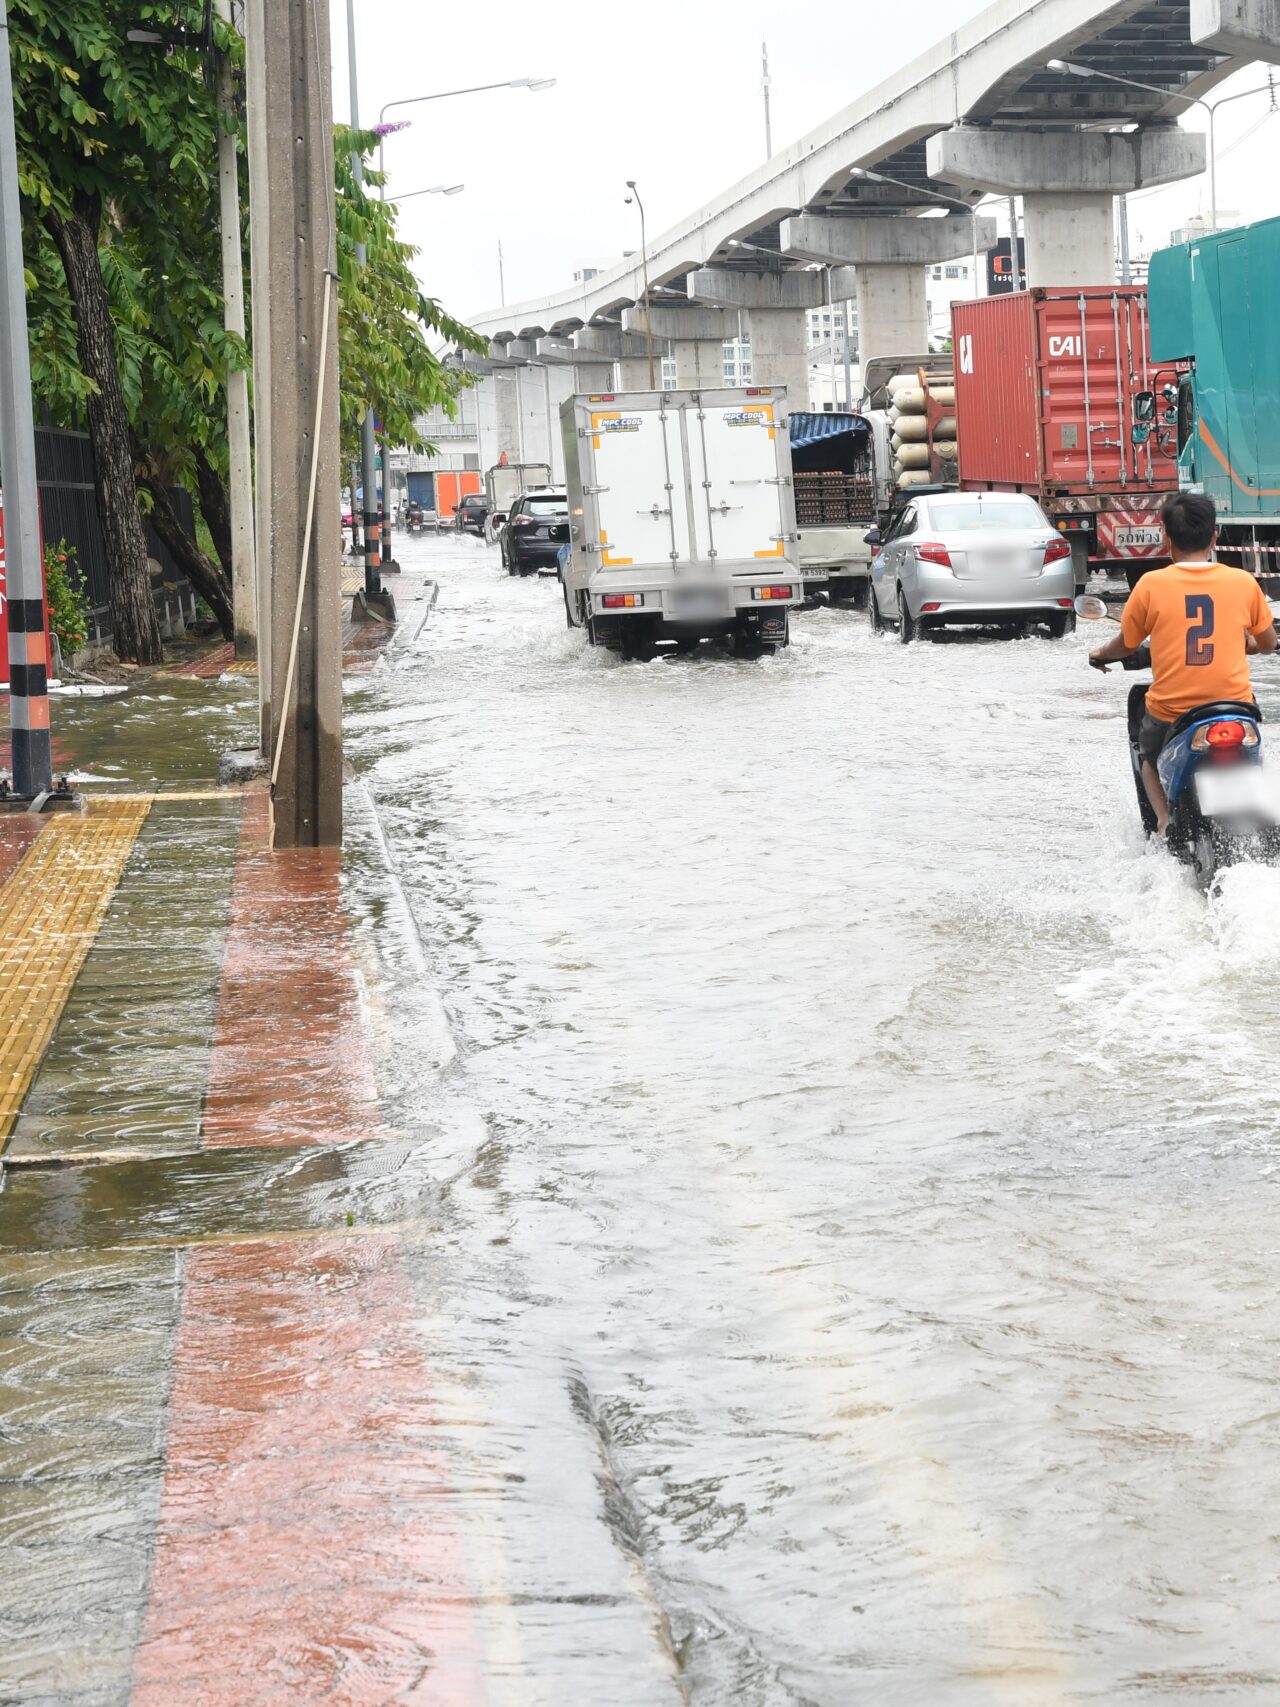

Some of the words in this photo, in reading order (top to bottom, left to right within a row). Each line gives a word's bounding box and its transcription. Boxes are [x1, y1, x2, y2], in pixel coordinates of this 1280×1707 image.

[1049, 335, 1081, 356] CAI
[601, 418, 621, 427] MPC
[621, 417, 643, 426] COOL
[723, 412, 742, 421] MPC
[742, 411, 764, 420] COOL
[1184, 594, 1215, 666] 2
